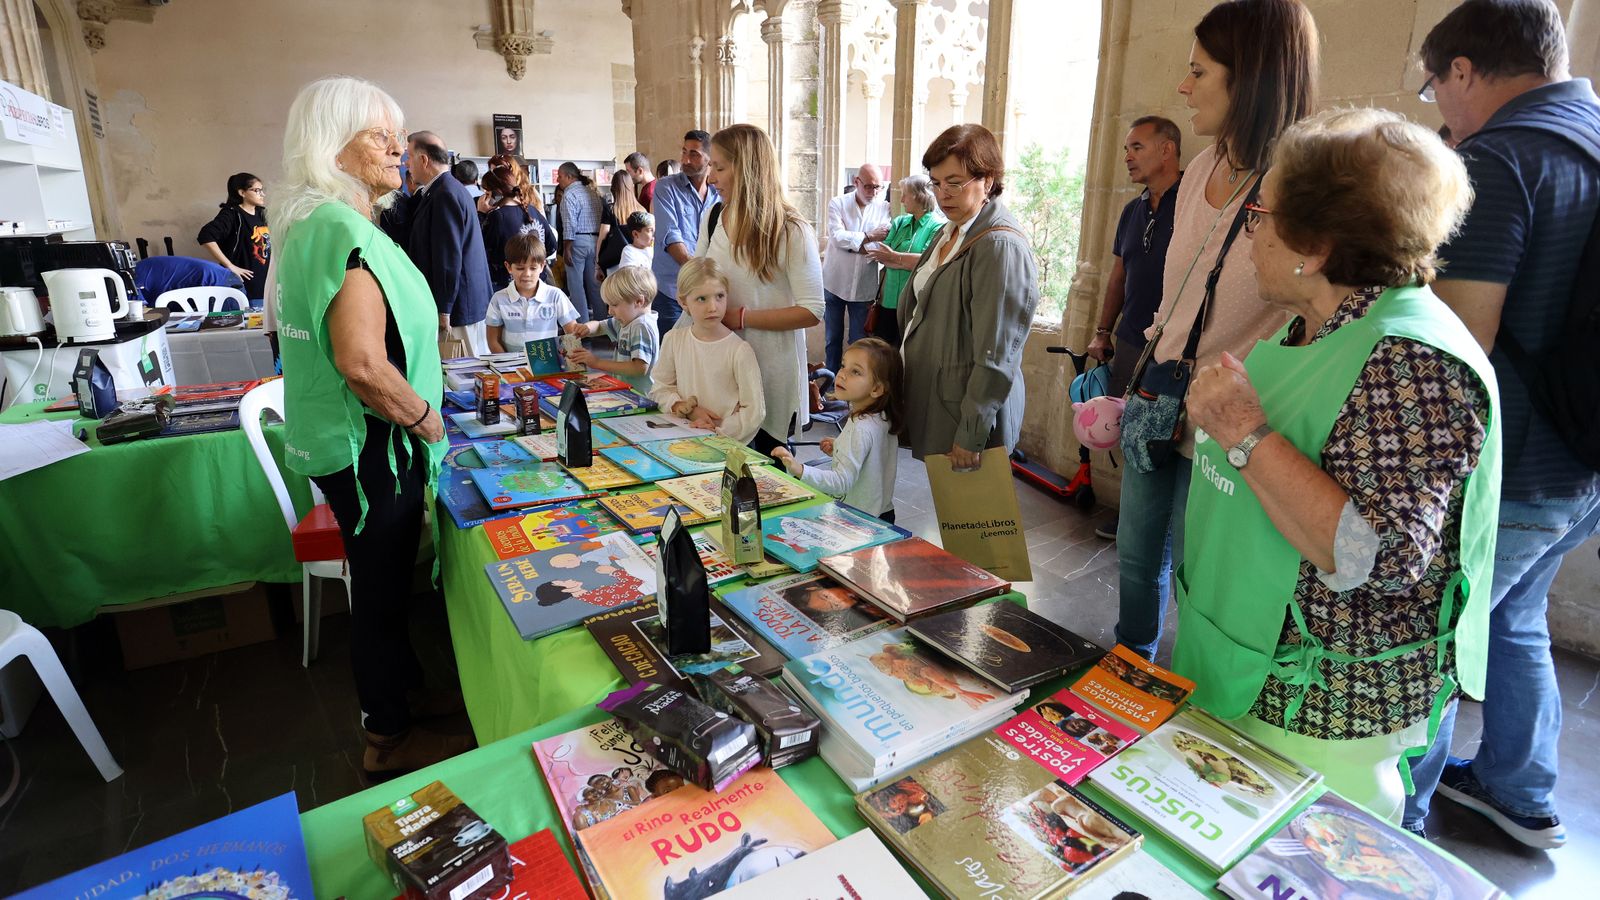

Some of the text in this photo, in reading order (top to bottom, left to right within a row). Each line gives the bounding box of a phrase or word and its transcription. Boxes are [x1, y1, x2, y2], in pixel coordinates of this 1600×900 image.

[1201, 453, 1235, 496] Oxfam
[941, 518, 1016, 531] PlanetadeLibros
[980, 527, 1018, 540] ¿Leemos?
[496, 563, 533, 603] SERÁ UN
[512, 558, 539, 580] BEBÉ
[752, 608, 795, 640] TODOS
[758, 596, 822, 642] A LA MESA
[610, 634, 644, 662] CACAO
[828, 654, 861, 684] bocados
[642, 690, 677, 711] Tierra
[650, 692, 684, 715] Madre
[1082, 685, 1151, 723] ensaladas
[1088, 679, 1144, 712] entrantes
[899, 719, 914, 732] en
[1147, 709, 1158, 718] y
[1006, 728, 1076, 775] postres
[1018, 721, 1073, 761] bebidas
[1071, 757, 1087, 767] y
[394, 805, 433, 828] Tierra
[623, 780, 765, 843] El Rino Realmente
[1110, 764, 1223, 841] CUSCÚS
[400, 811, 441, 837] Madre
[650, 810, 743, 867] RUDO
[151, 849, 190, 872] DOS
[196, 841, 288, 858] HERMANOS
